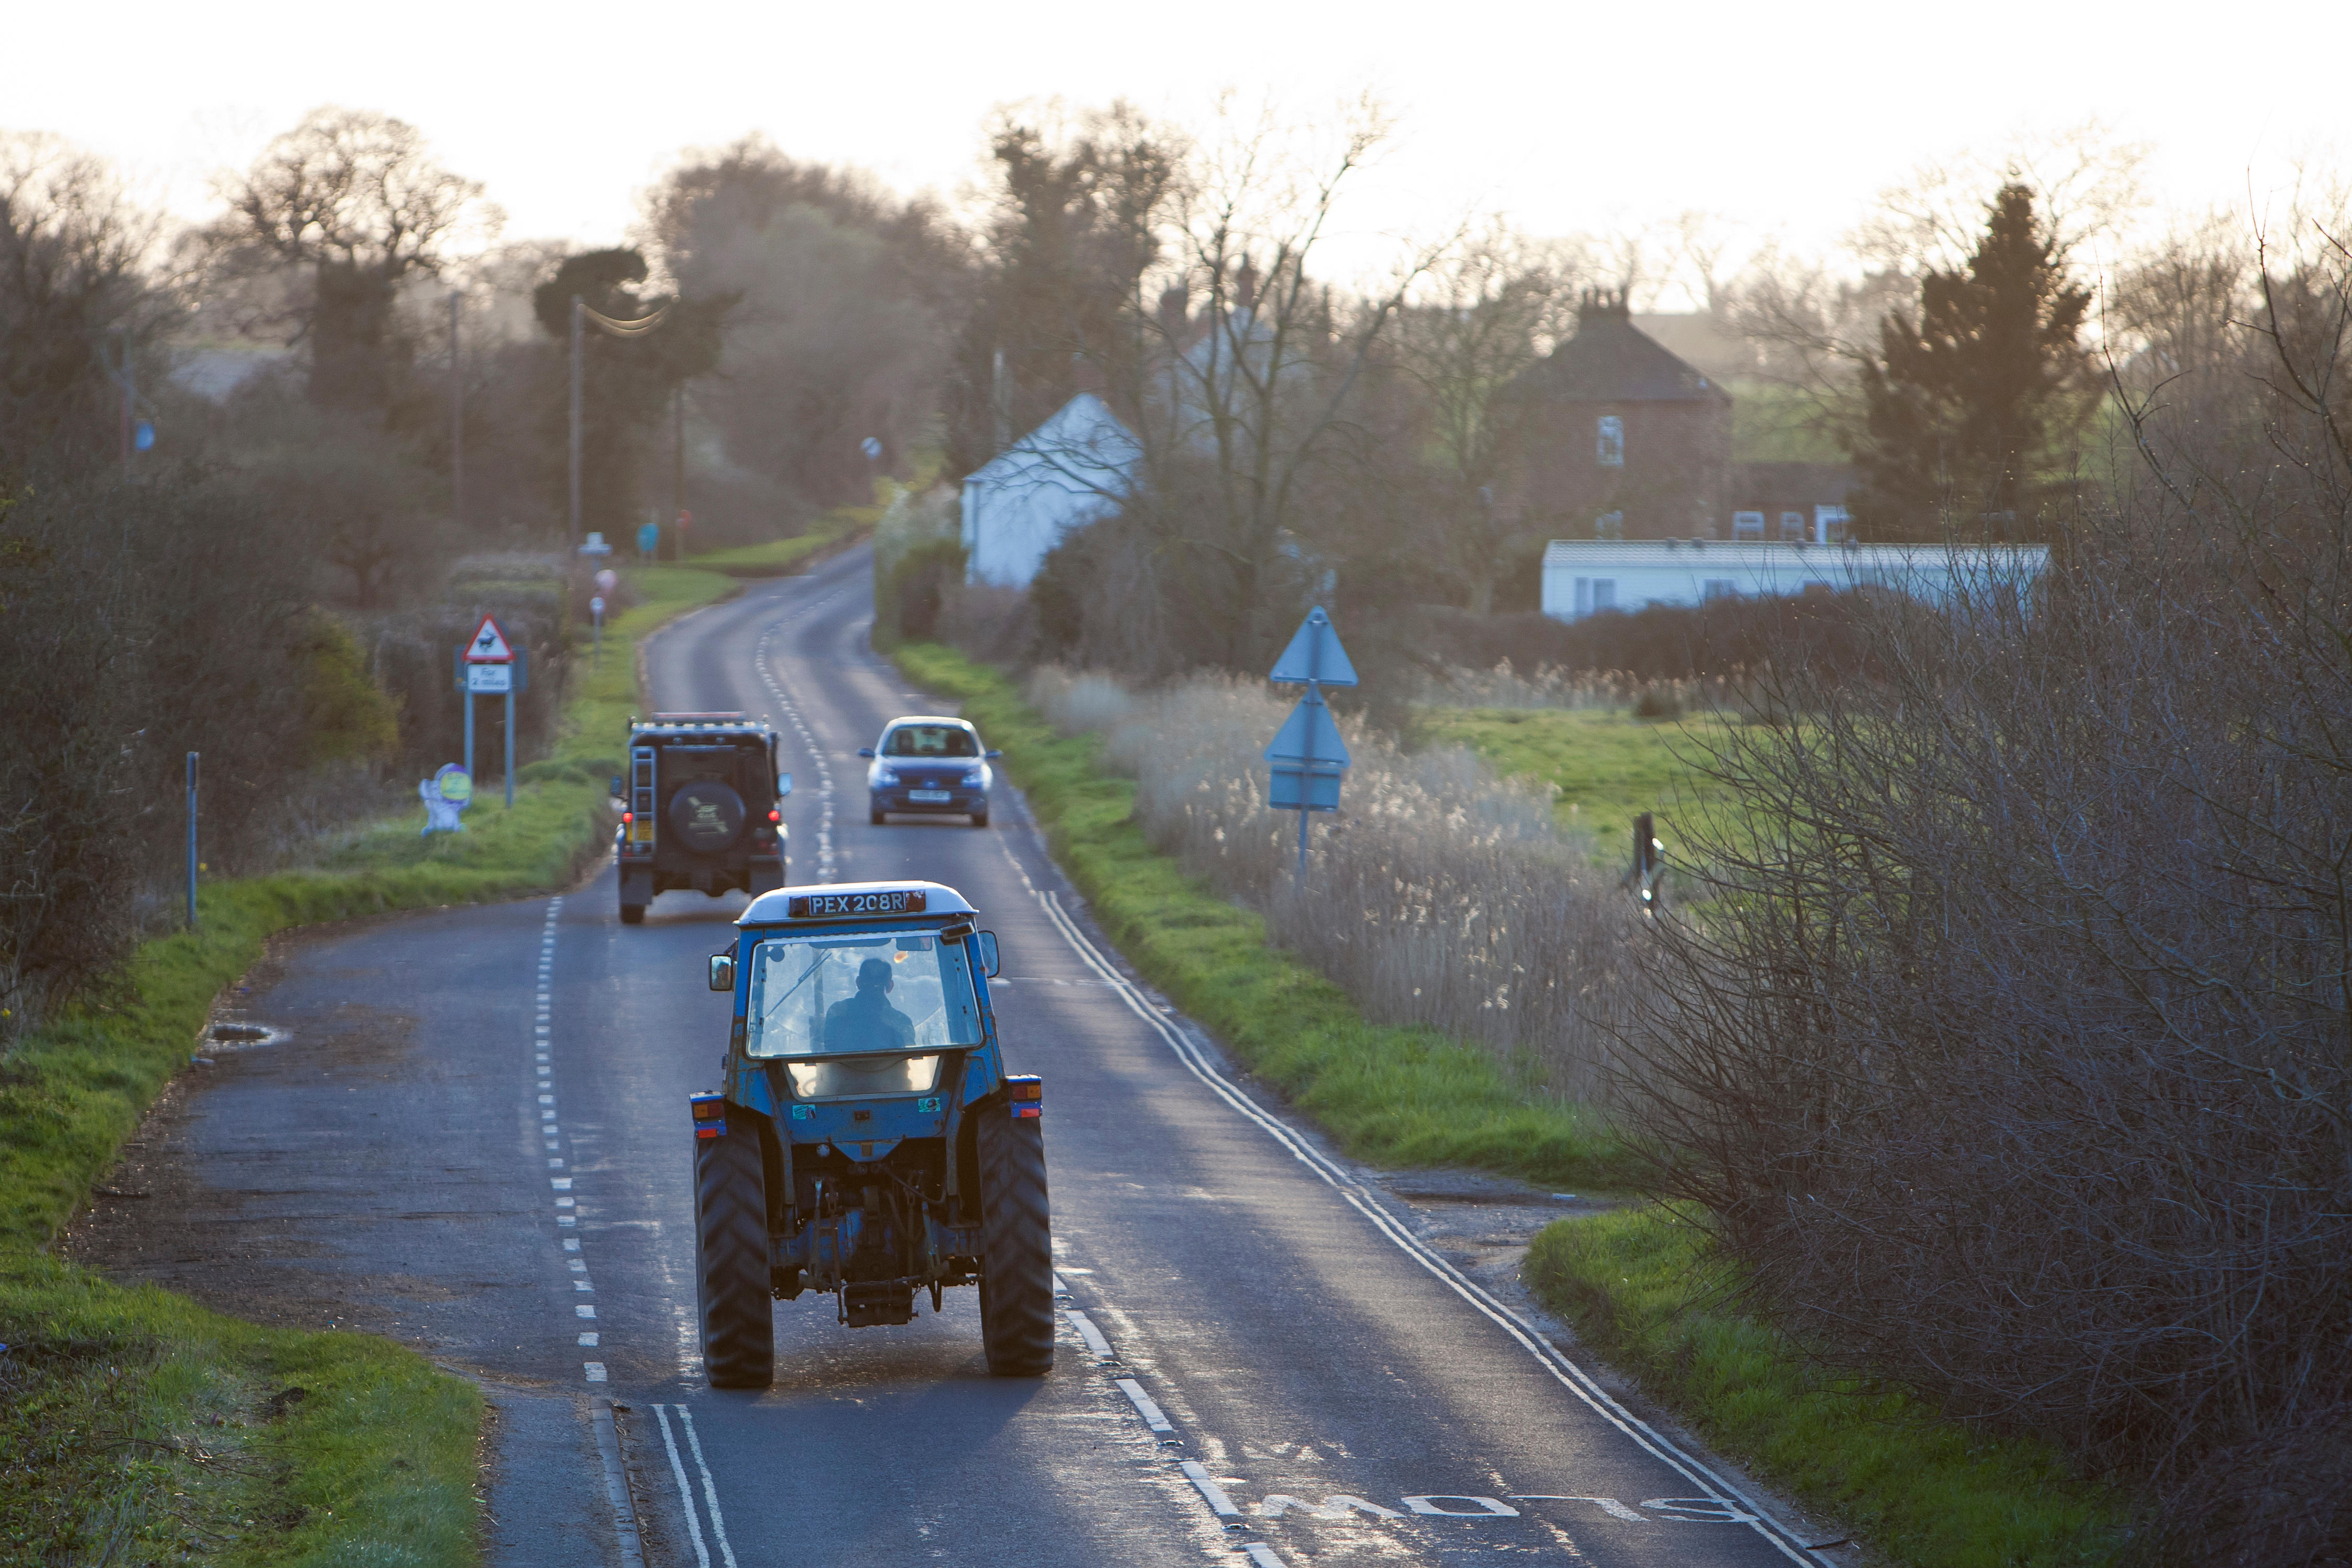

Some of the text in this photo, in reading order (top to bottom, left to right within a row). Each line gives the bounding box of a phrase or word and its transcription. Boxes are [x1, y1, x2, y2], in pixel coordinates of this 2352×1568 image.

[812, 893, 903, 913] PEX 208R
[1261, 1494, 1760, 1523] SLOW
